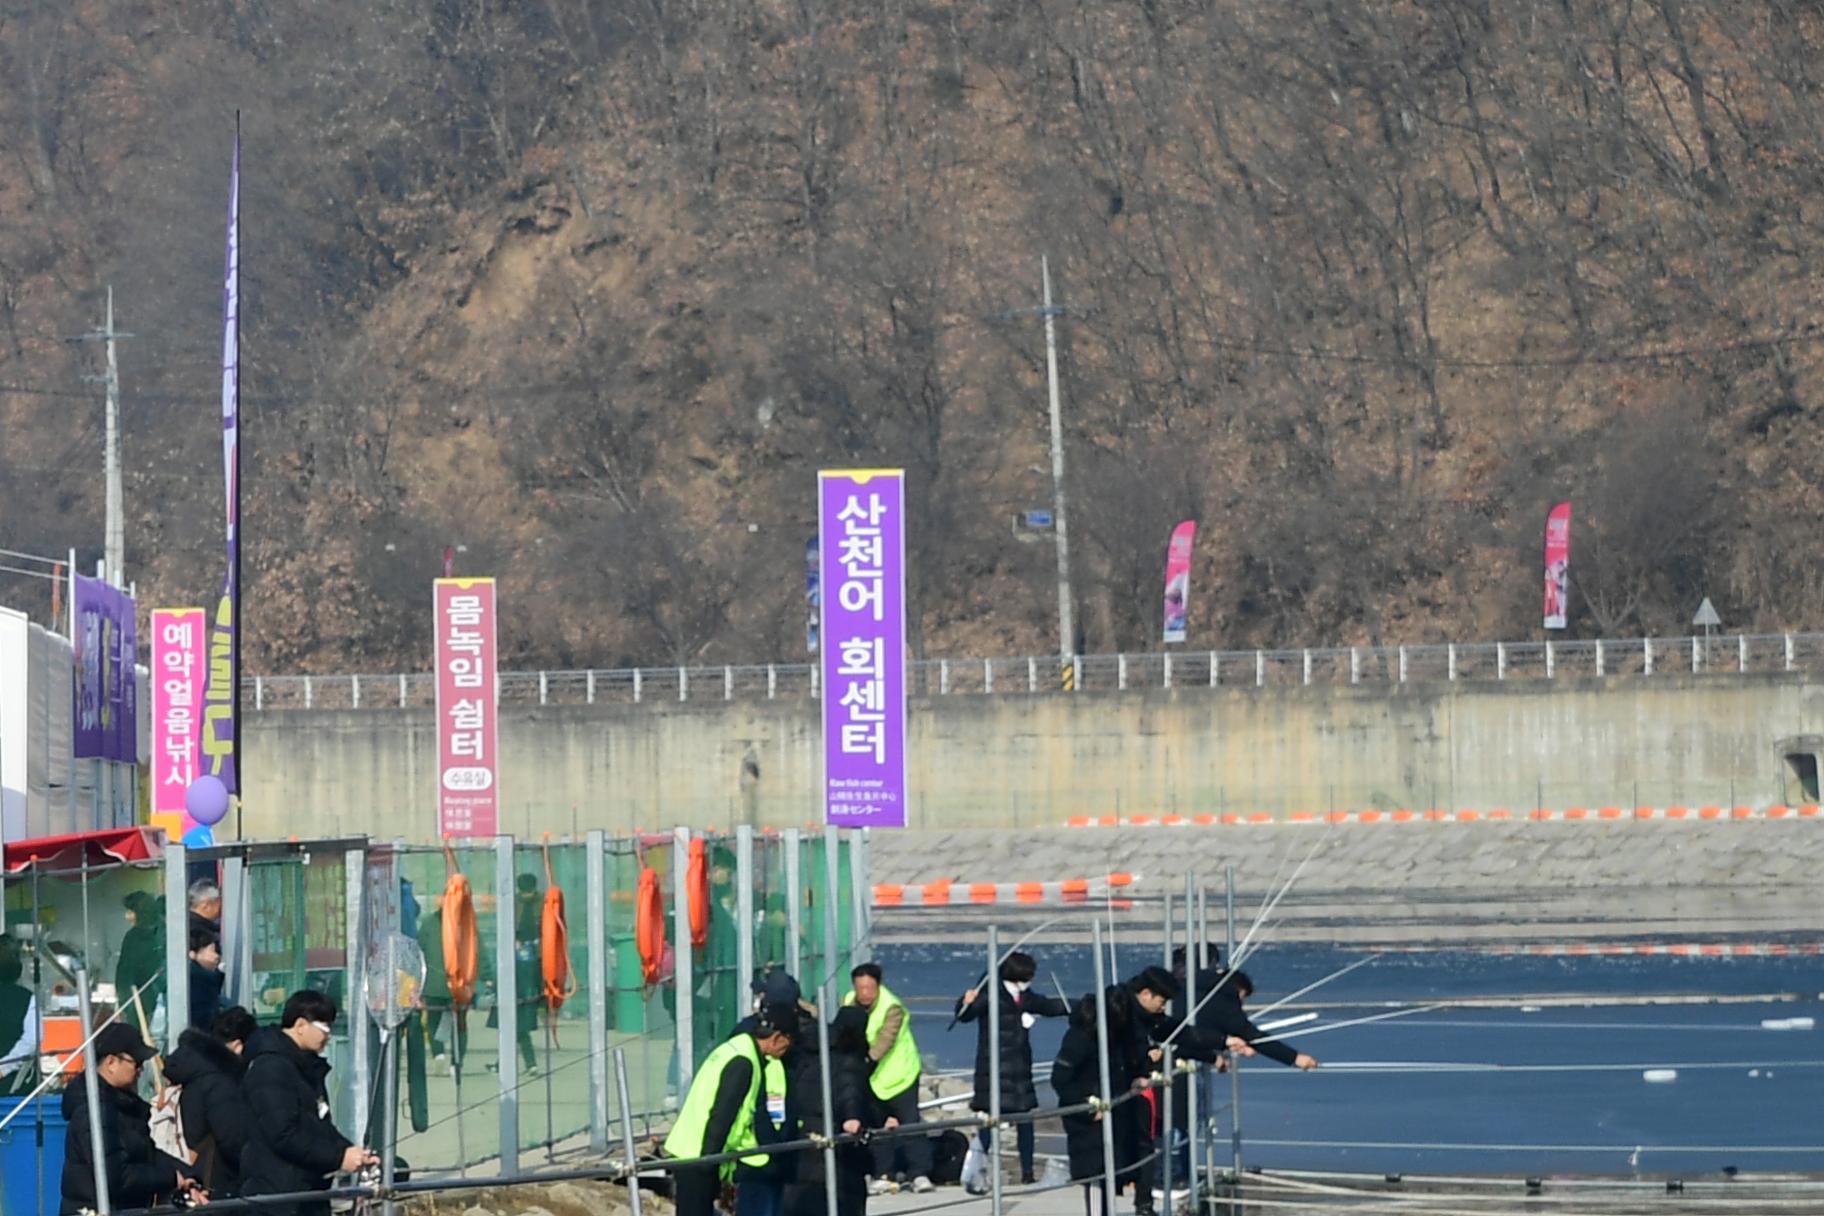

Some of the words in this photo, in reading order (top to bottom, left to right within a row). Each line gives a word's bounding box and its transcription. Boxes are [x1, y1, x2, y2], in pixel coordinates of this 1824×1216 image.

[837, 494, 886, 621] 산천어
[446, 595, 484, 687] 몸녹임
[449, 699, 484, 760] 쉼터
[838, 637, 885, 765] 회센터
